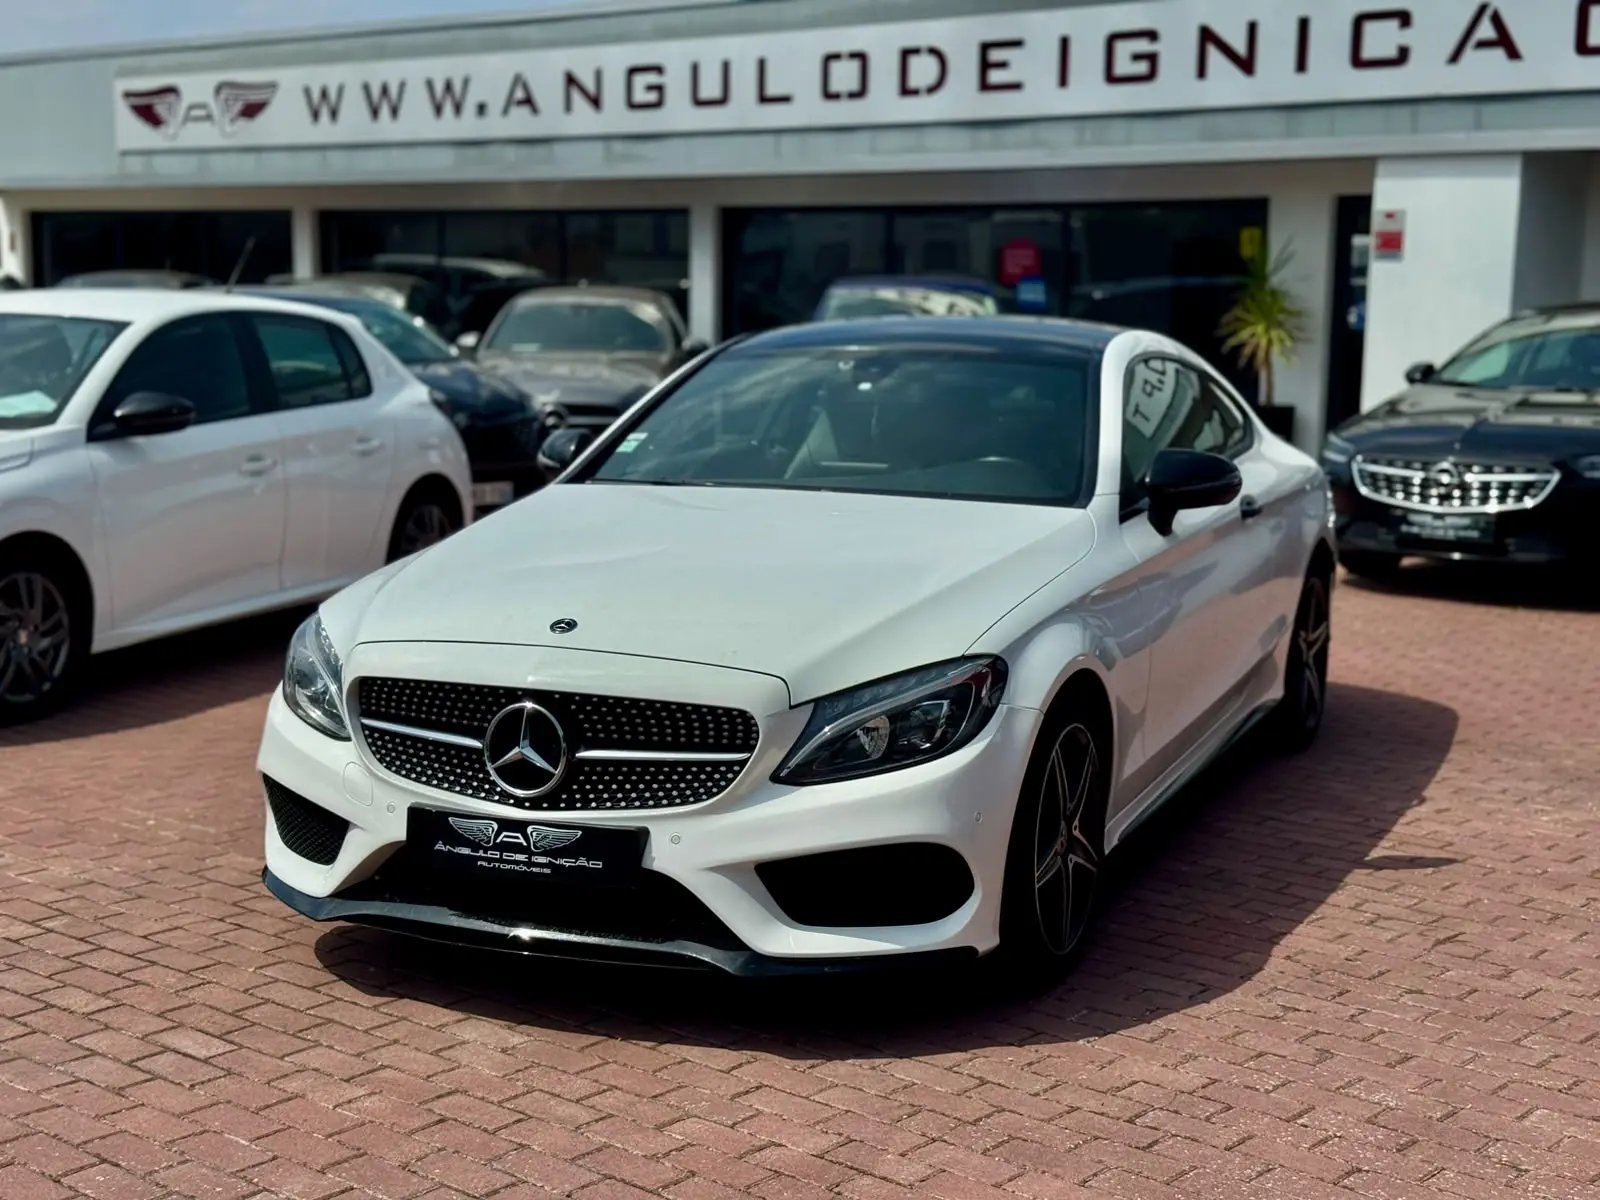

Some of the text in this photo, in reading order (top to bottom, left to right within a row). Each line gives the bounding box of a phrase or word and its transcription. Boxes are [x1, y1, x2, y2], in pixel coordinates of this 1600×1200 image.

[496, 831, 527, 846] A
[434, 840, 603, 869] ÂNGULO DE IGNIÇÃO
[477, 861, 552, 874] AUTOMÓVEIS
